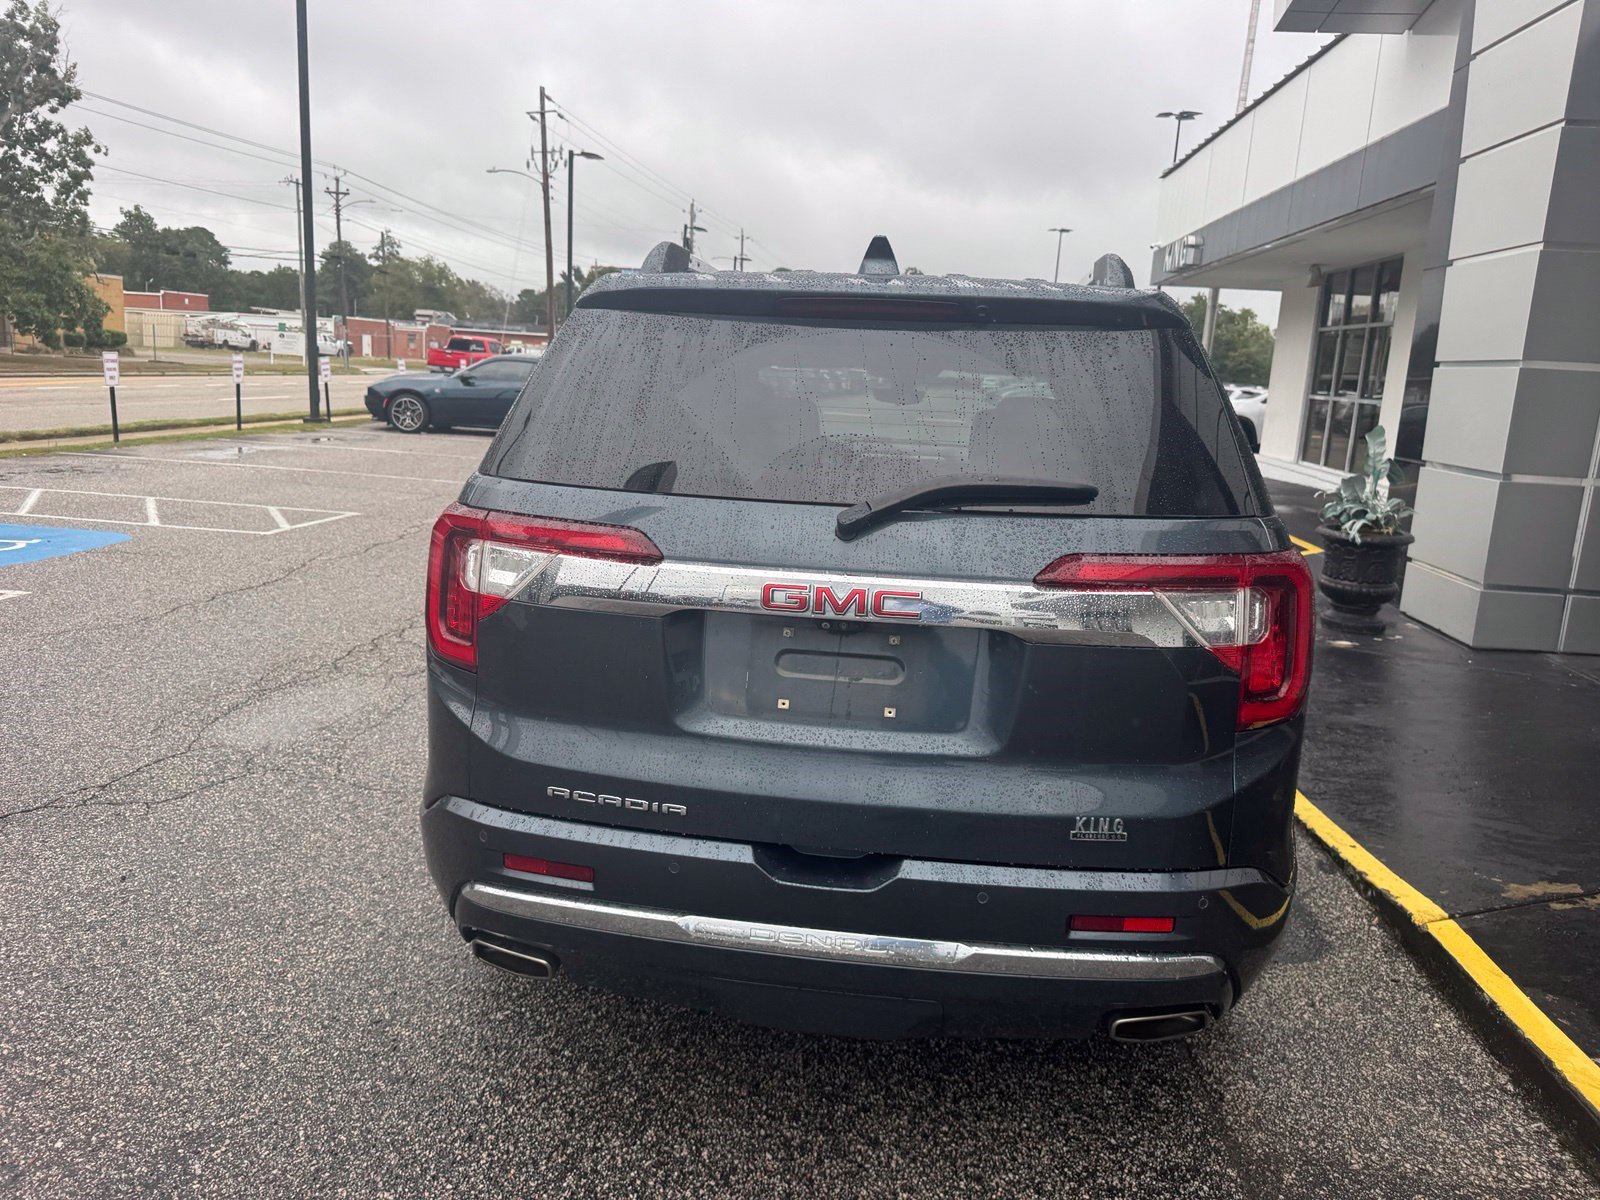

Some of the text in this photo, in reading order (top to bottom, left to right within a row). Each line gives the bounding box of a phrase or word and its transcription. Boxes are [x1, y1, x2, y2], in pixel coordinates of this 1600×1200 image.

[762, 583, 923, 619] GMC
[547, 786, 687, 816] ACADIA
[1075, 816, 1123, 833] KING
